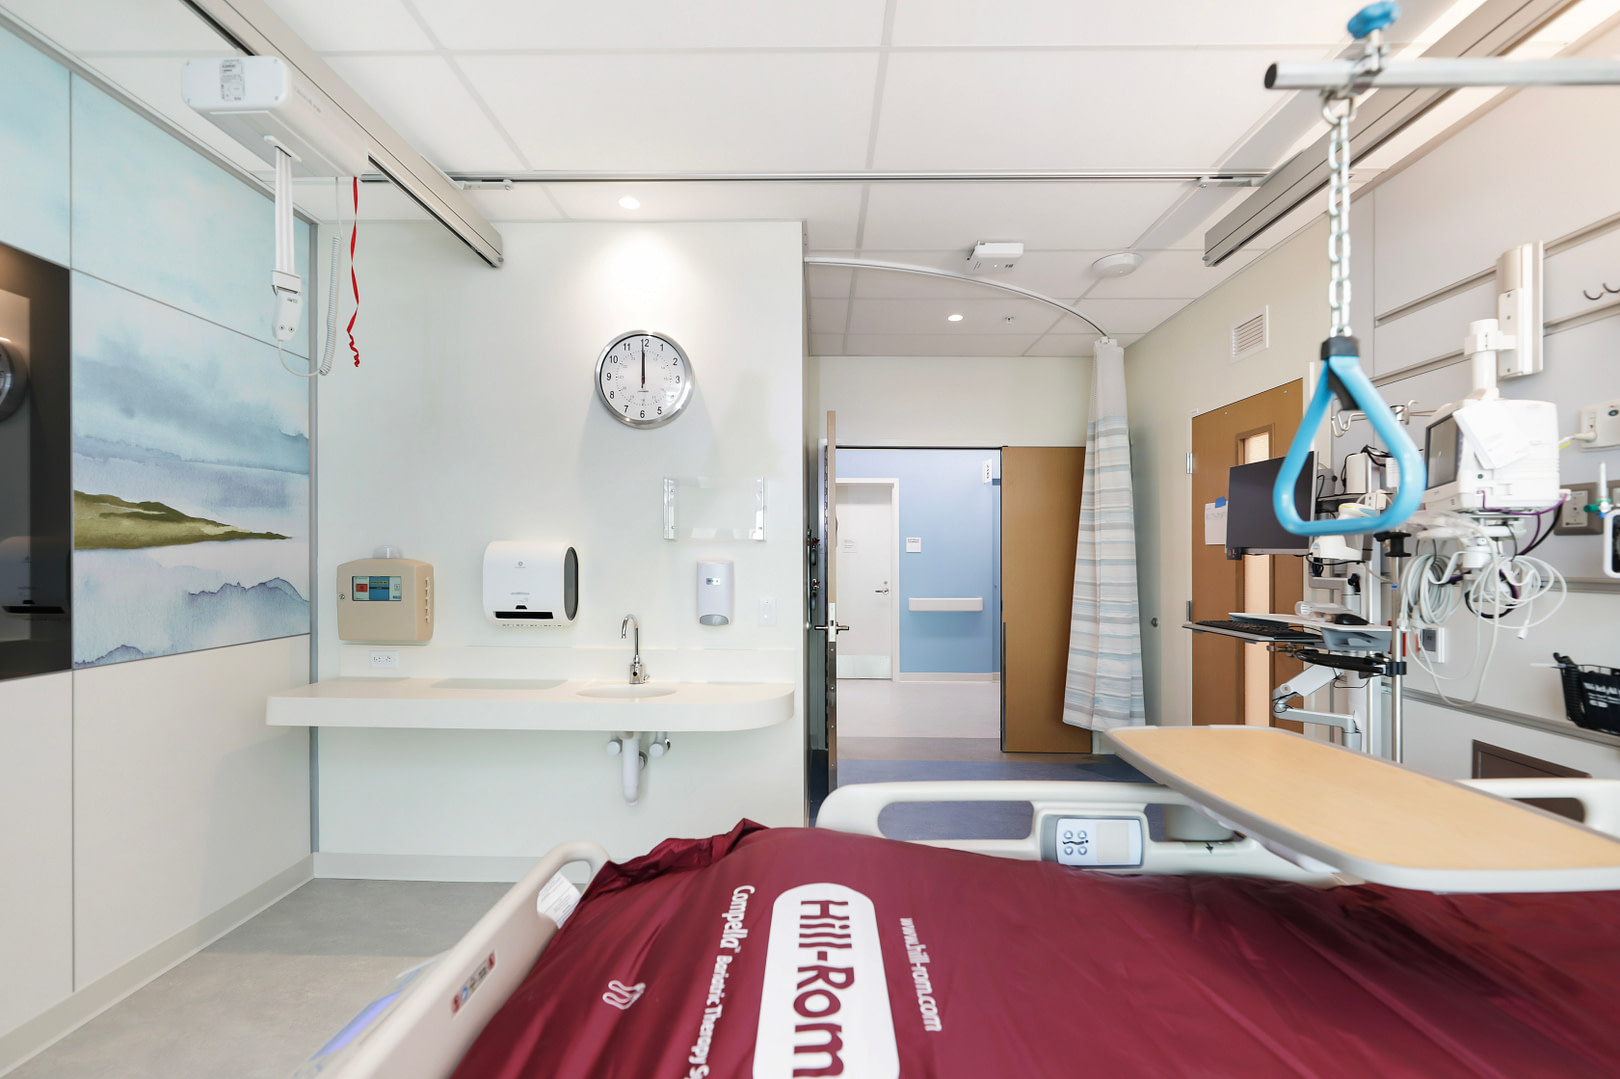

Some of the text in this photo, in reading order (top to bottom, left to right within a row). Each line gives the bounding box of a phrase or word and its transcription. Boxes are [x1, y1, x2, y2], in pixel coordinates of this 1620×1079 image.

[623, 343, 631, 351] 11
[641, 339, 650, 347] 12
[609, 355, 618, 363] 10
[606, 373, 611, 381] 9
[675, 376, 680, 384] 3
[609, 391, 614, 399] 8
[624, 405, 629, 413] 7
[640, 410, 645, 418] 6
[900, 917, 943, 1033] www.hill-rom.com
[706, 955, 733, 1007] Bariatric
[792, 899, 856, 1079] Hill-Rom
[688, 1004, 723, 1065] Therapy
